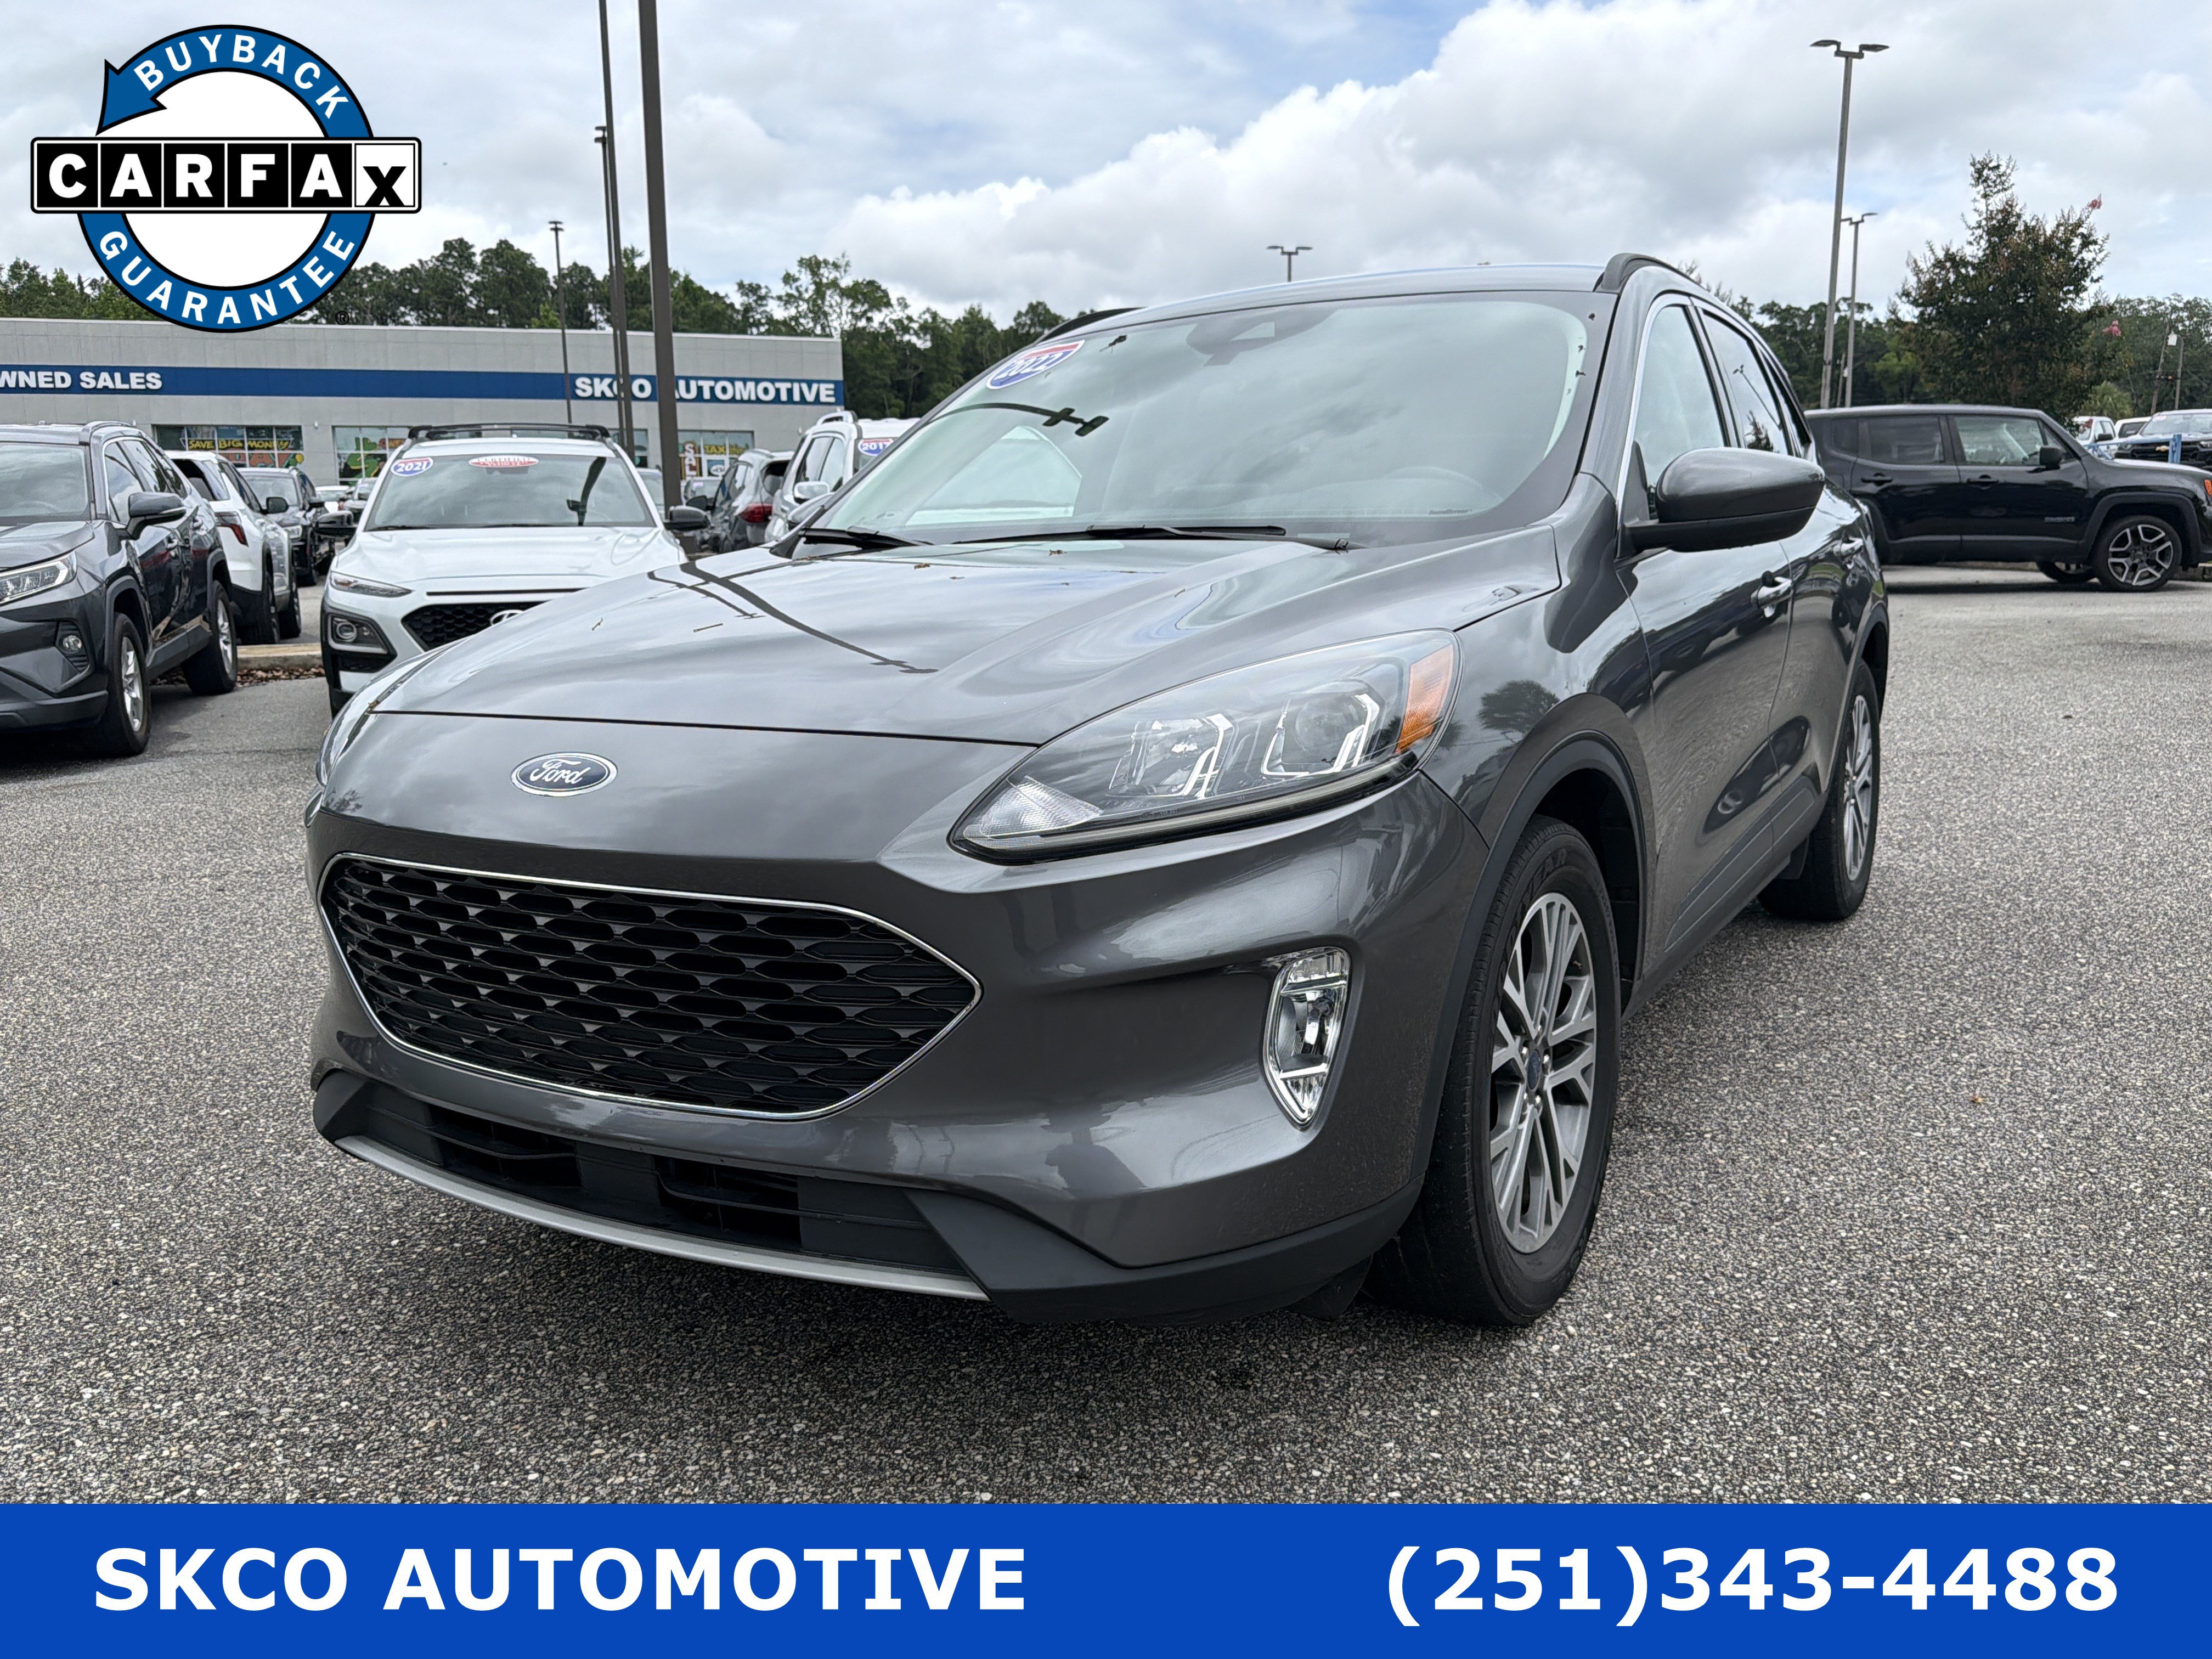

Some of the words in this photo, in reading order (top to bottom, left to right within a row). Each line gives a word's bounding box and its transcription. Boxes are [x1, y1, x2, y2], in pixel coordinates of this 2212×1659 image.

[80, 371, 162, 390] SALES
[675, 379, 836, 403] UTOMOTIVE
[189, 440, 214, 449] SAVE
[219, 439, 243, 449] BIG
[247, 440, 289, 450] MONY
[704, 445, 725, 454] TAX
[396, 461, 428, 472] 2021
[684, 443, 697, 476] SAL
[530, 759, 591, 785] Ford
